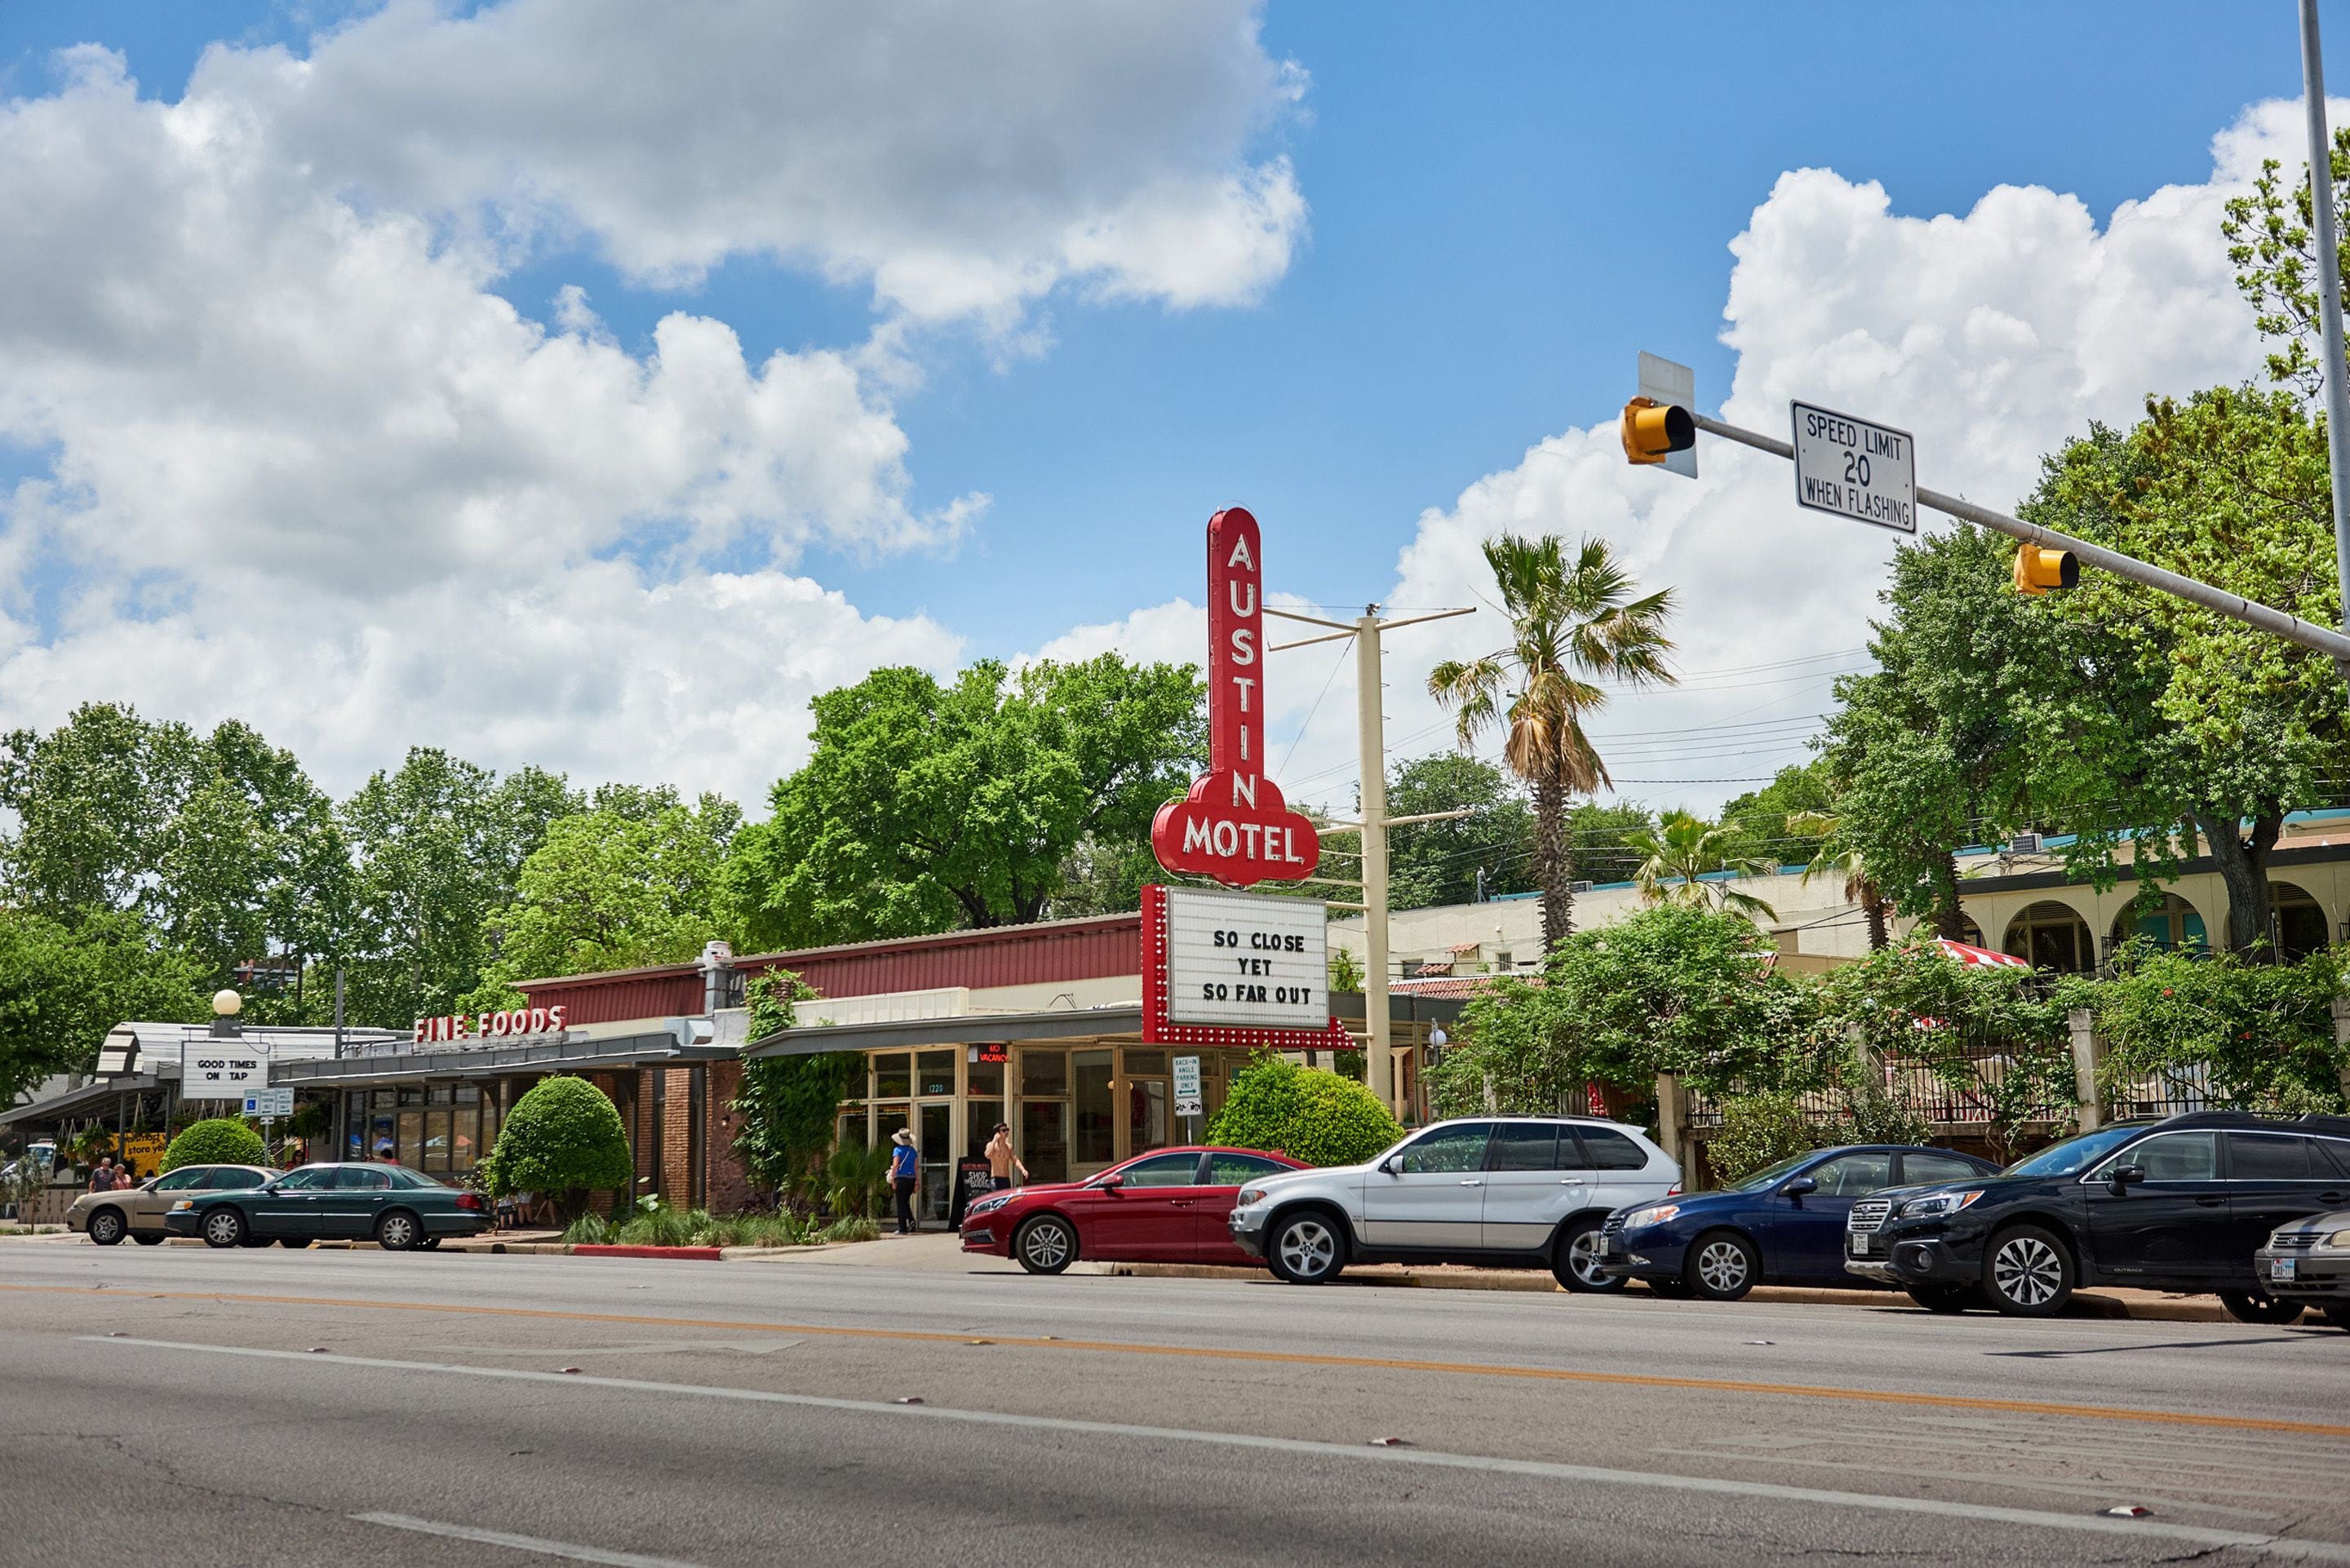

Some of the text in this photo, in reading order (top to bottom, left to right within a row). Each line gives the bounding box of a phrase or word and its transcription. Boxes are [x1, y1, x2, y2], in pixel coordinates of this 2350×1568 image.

[1807, 413, 1901, 461] SPEED LIMIT
[1843, 450, 1870, 487] 20
[1805, 476, 1909, 525] WHEN FLASHING
[1227, 533, 1257, 811] AUSTIN
[1183, 814, 1306, 864] MOTEL
[1214, 930, 1305, 953] SO CLOSE
[1238, 957, 1271, 976] YET
[1204, 983, 1310, 1005] SO FAR OUT
[415, 1005, 566, 1043] FINE FOODS
[979, 1053, 1009, 1062] VACANCY
[989, 1044, 1000, 1052] NO
[198, 1060, 257, 1069] GOOD TIMES
[206, 1072, 248, 1080] ON TAP
[929, 1084, 943, 1093] 1220
[127, 1145, 150, 1154] store
[969, 1171, 987, 1180] SHOP
